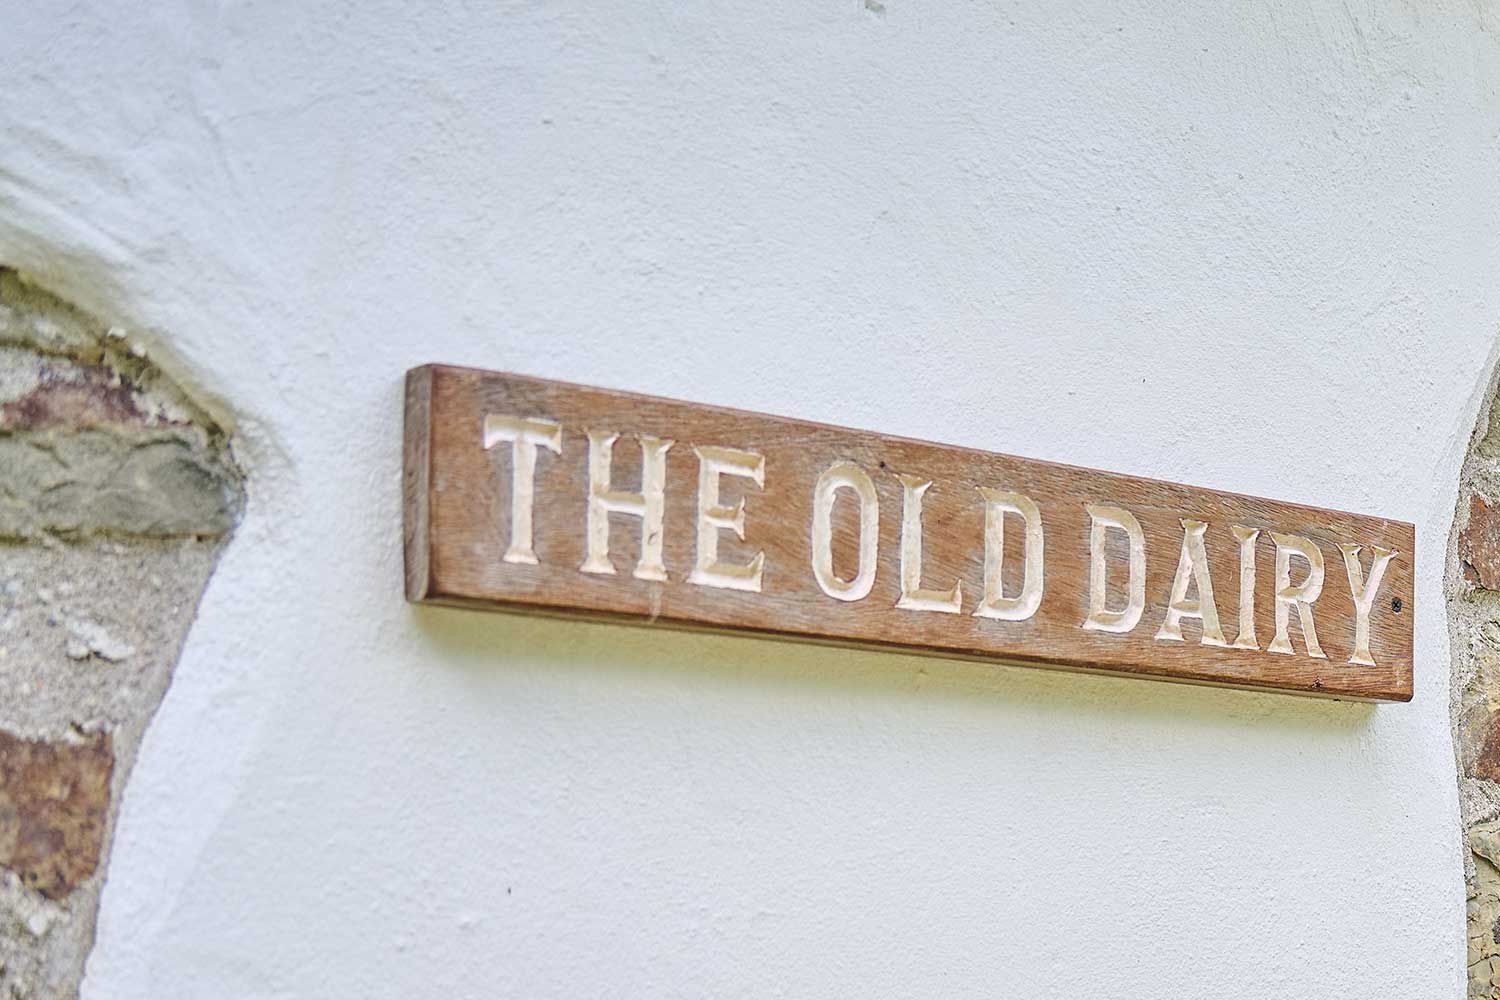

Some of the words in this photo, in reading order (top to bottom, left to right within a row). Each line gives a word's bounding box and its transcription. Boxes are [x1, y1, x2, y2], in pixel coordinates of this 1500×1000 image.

[482, 414, 766, 593] THE
[811, 460, 1044, 622] OLD
[1081, 502, 1400, 667] DAIRY
